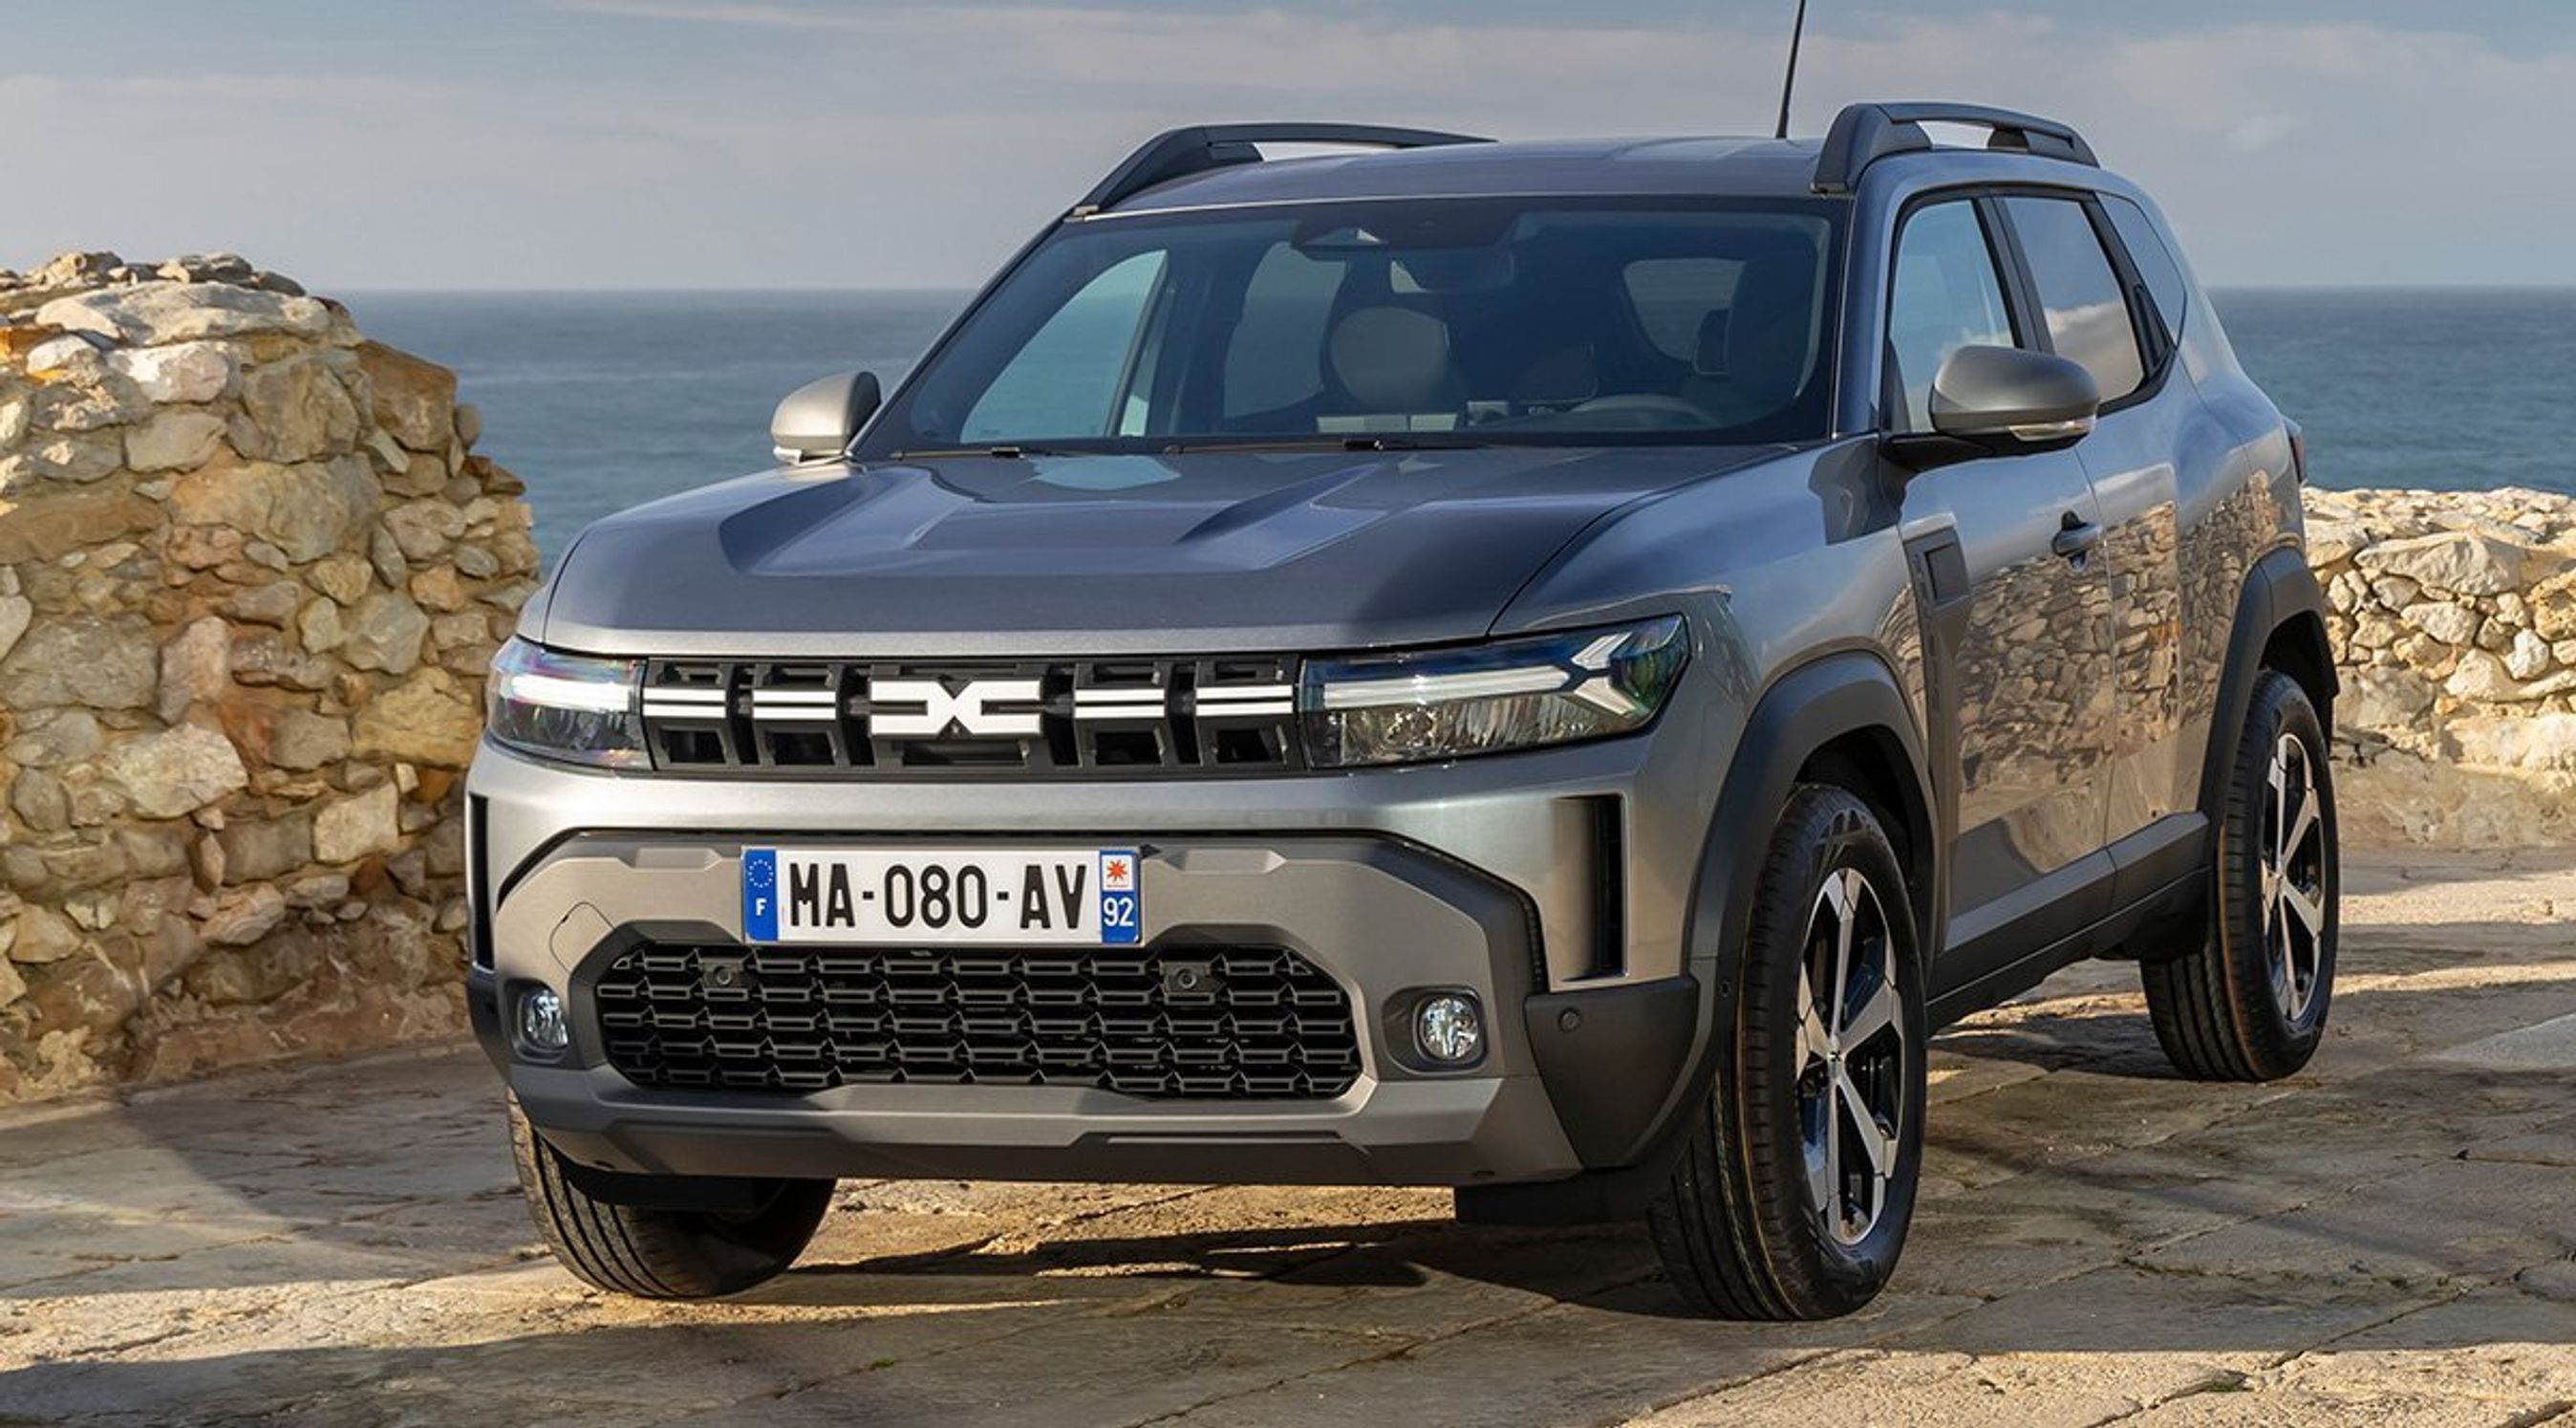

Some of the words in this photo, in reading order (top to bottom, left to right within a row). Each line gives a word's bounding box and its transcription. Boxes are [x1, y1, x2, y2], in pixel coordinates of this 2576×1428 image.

[755, 898, 767, 917] F
[789, 863, 1087, 929] MA-080-AV
[1103, 897, 1135, 927] 92
